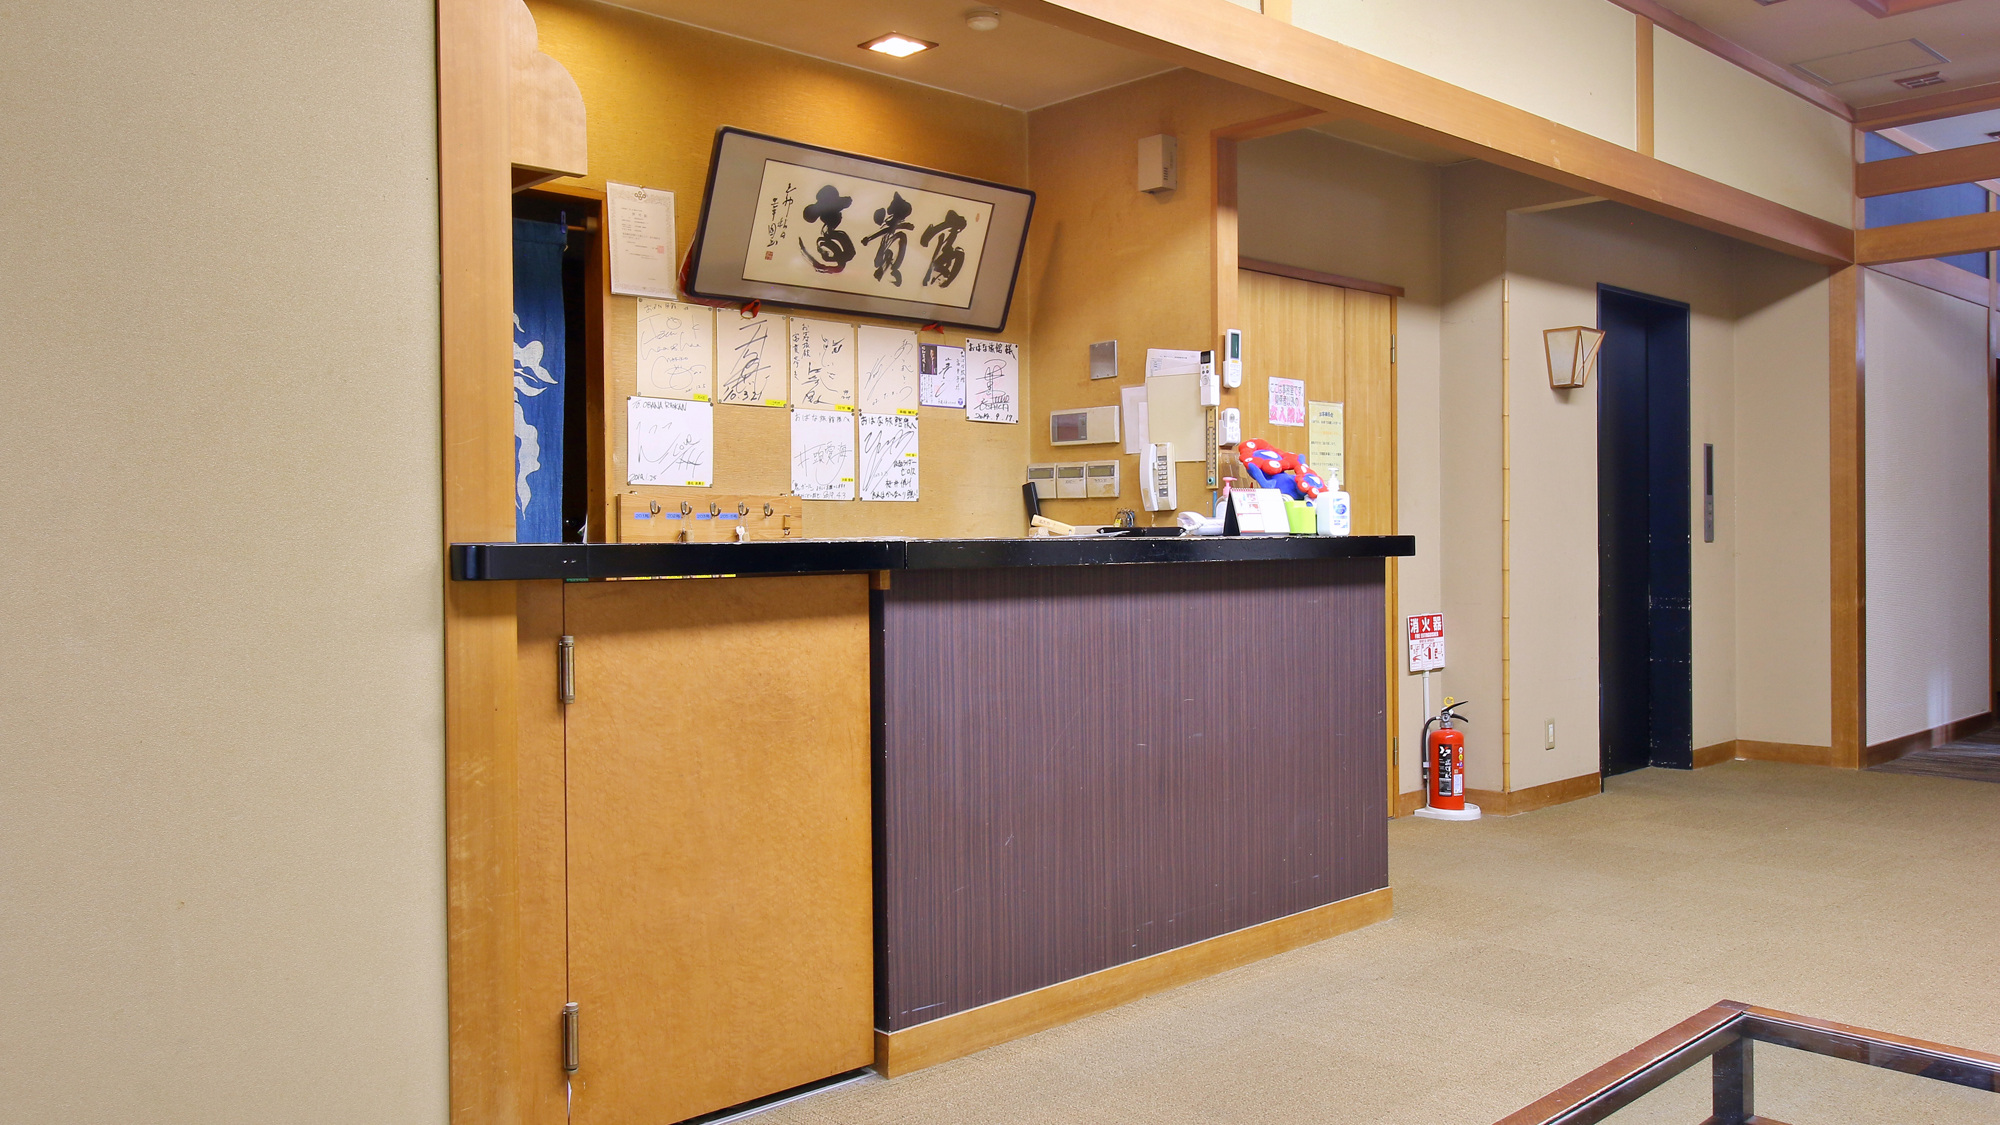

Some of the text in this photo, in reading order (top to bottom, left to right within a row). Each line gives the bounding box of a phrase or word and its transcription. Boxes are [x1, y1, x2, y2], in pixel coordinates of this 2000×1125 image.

[1269, 404, 1305, 424] 立入禁止
[1410, 616, 1442, 634] 消火器
